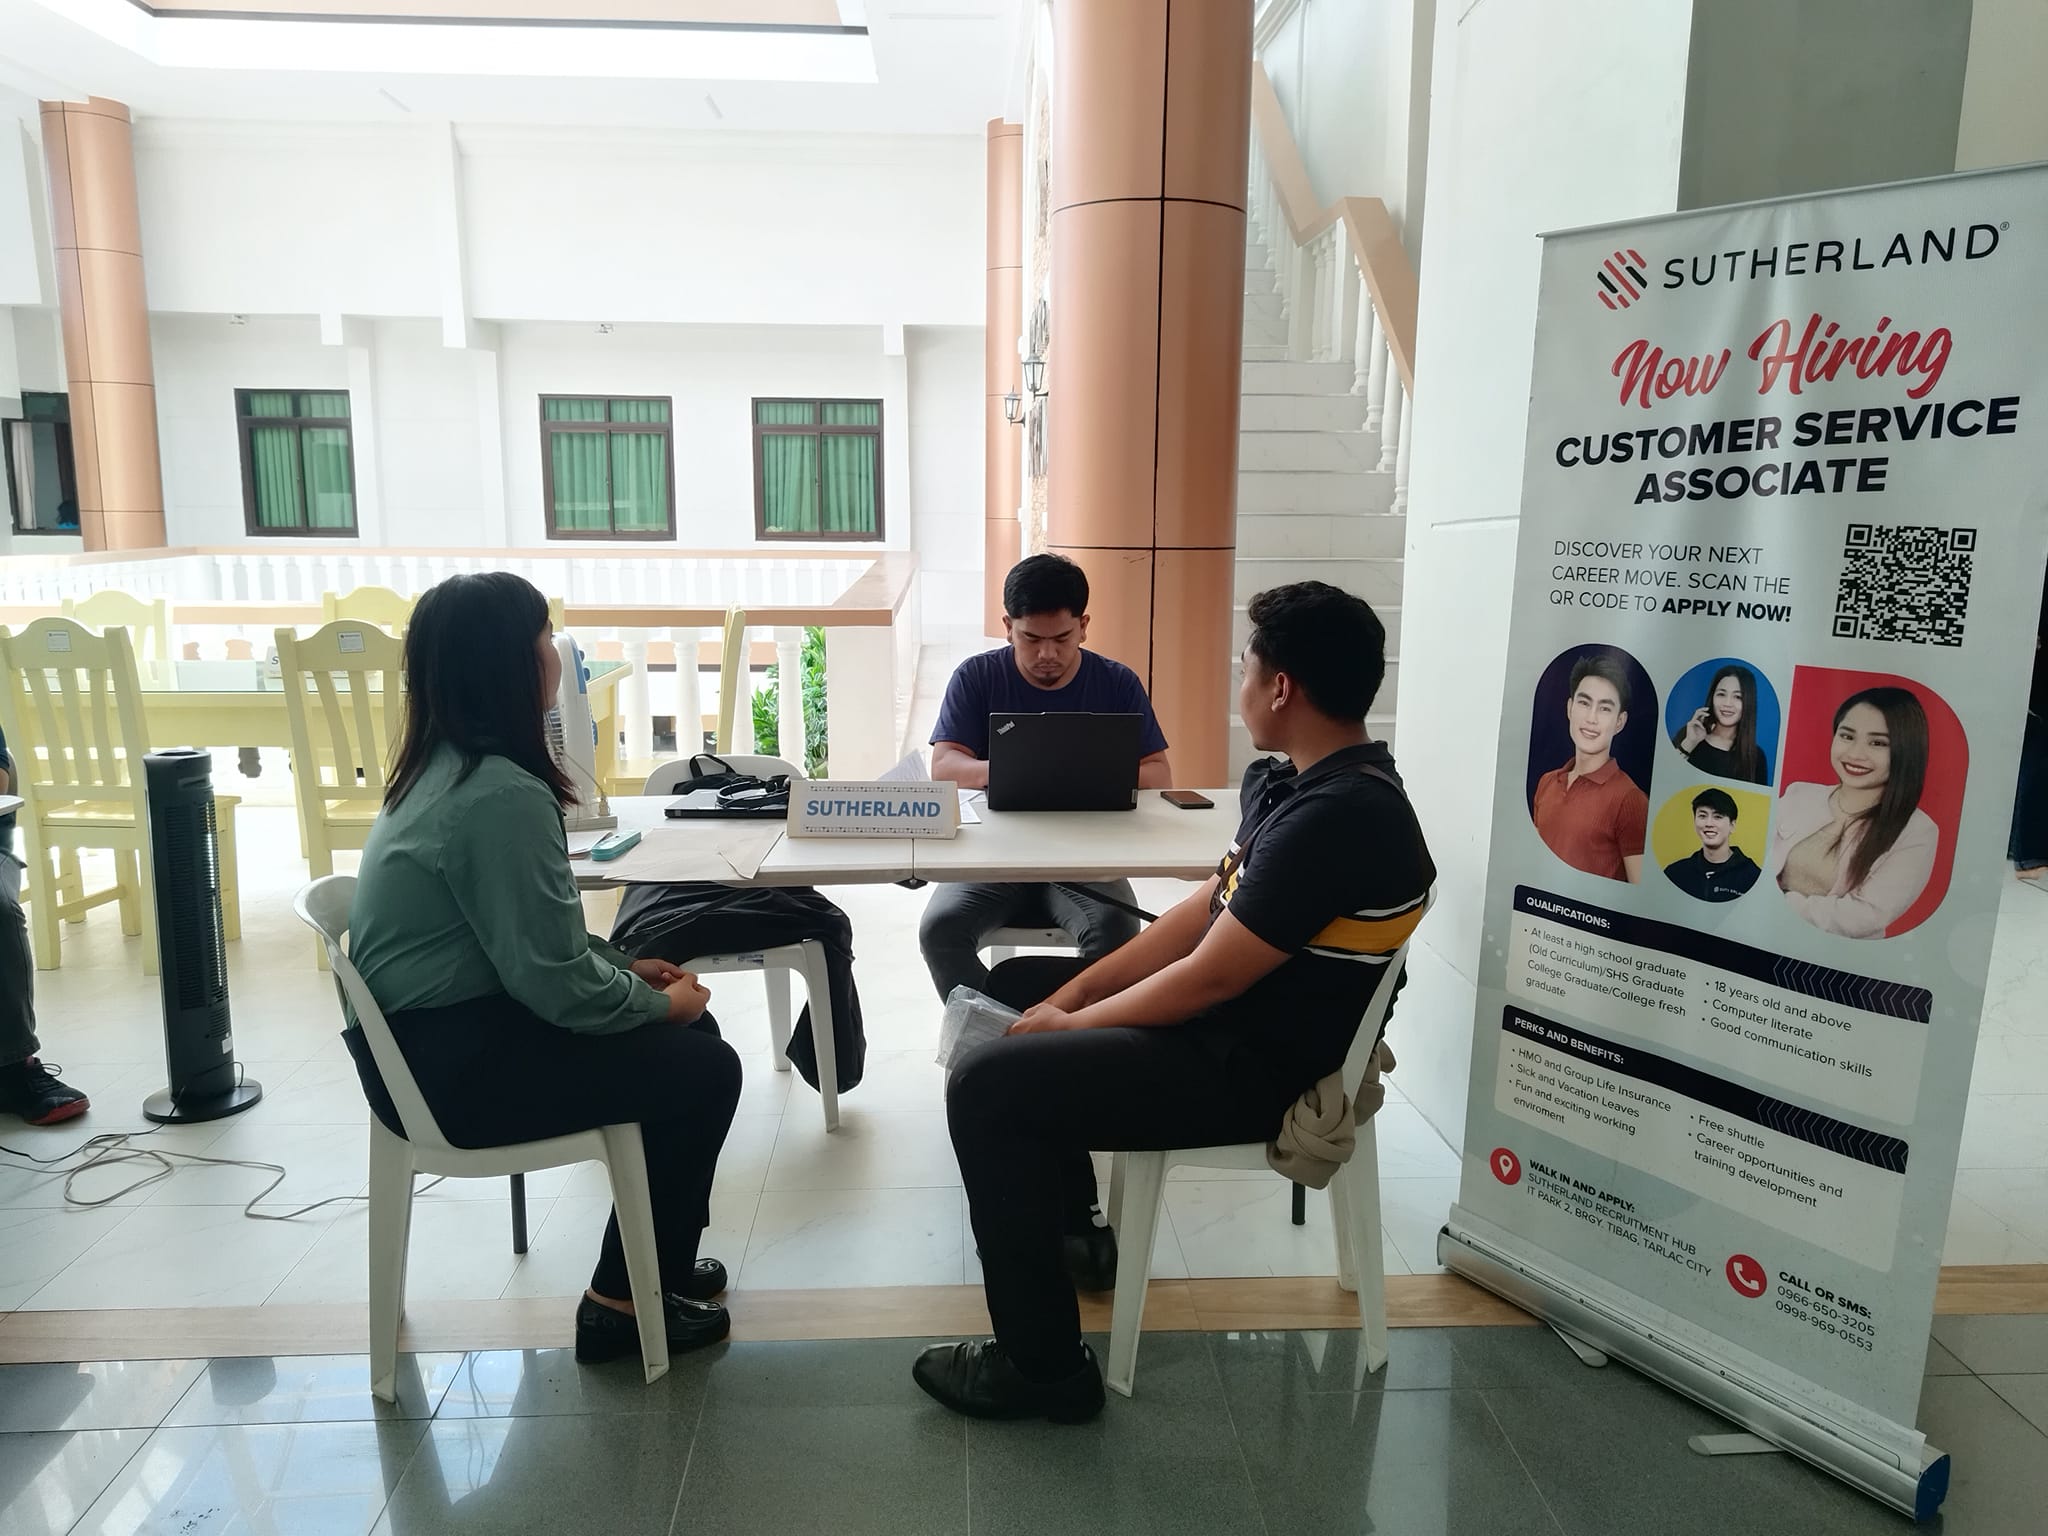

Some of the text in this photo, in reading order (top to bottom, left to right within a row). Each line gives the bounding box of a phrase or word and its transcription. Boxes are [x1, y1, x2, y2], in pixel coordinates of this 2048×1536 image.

[1611, 313, 1952, 408] Now Hiring
[1556, 396, 2020, 467] CUSTOMER SERVICE
[1634, 457, 1889, 504] ASSOCIATE
[1554, 540, 1763, 565] DISCOVER YOUR NEXT
[1549, 590, 1792, 622] QR CODE TO APPLY NOW!
[1552, 565, 1790, 595] CAREER MOVE. SCAN THE
[806, 800, 941, 818] SUTHERLAND
[1526, 896, 1611, 929] QUALIFICATIONS:
[1529, 943, 1685, 998] (Old Curriculum)/SHS Graduate
[1531, 927, 1687, 980] At least a high school graduate
[1526, 976, 1566, 998] graduate
[1527, 959, 1686, 1017] College Graduate/College fresh
[1714, 980, 1852, 1032] 18 years old and above
[1514, 1016, 1624, 1064] PERKS AND BENEFITS:
[1712, 998, 1813, 1040] Computer literate
[1710, 1016, 1873, 1078] Good communication skills
[1517, 1063, 1640, 1118] Sick and Vacation Leaves
[1518, 1047, 1672, 1112] HMO and Group Life Insurance
[1513, 1096, 1565, 1124] enviroment
[1515, 1079, 1636, 1136] Fun and exciting working
[1698, 1114, 1765, 1149] Free shuttle
[1529, 1159, 1636, 1213] WALK IN AND APPLY:
[1694, 1150, 1817, 1207] training development
[1696, 1132, 1843, 1198] Career opportunities and
[1527, 1185, 1536, 1195] IT
[1538, 1190, 1562, 1210] PARK
[1607, 1221, 1640, 1246] TIBAG,
[1643, 1238, 1684, 1265] TARLAC
[1686, 1259, 1712, 1277] CITY
[1528, 1173, 1697, 1256] SUTHERLAND RECRUITMENT HUB
[1777, 1285, 1875, 1337] 0966-650-3205
[1779, 1271, 1872, 1319] CALL OR SMS:
[1776, 1300, 1873, 1352] 0998-969-0553
